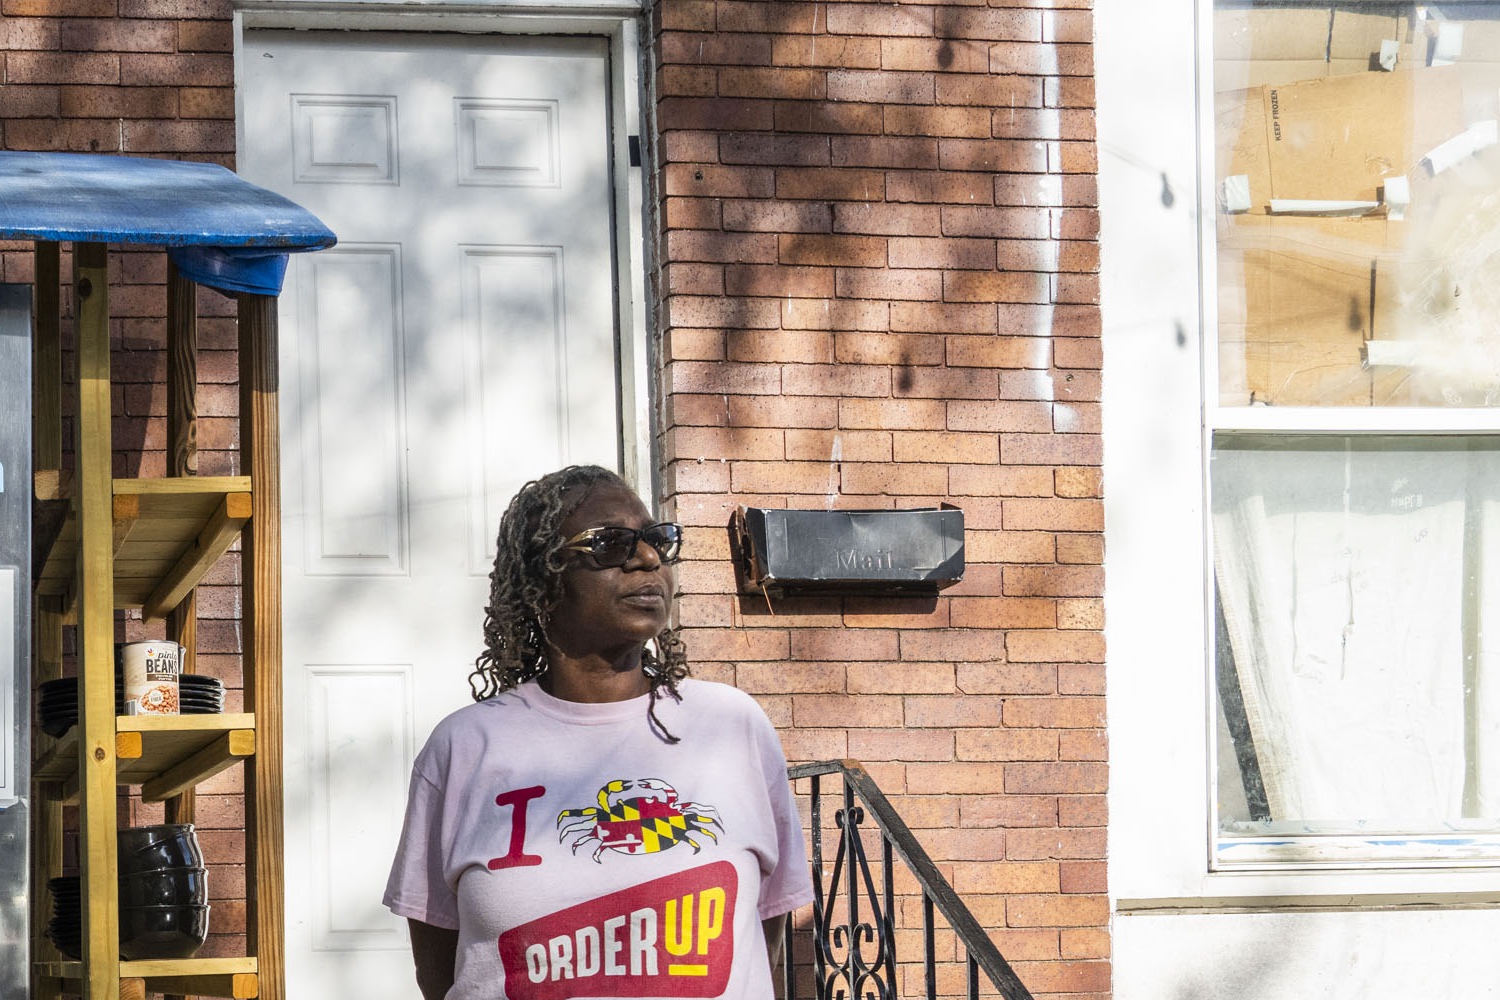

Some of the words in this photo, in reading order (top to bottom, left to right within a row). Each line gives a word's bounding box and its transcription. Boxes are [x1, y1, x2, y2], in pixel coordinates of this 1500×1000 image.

[1271, 90, 1279, 120] FROZEN
[1274, 122, 1282, 141] KEEP
[835, 550, 893, 570] Mail
[146, 659, 177, 674] BEANS
[487, 786, 546, 870] I
